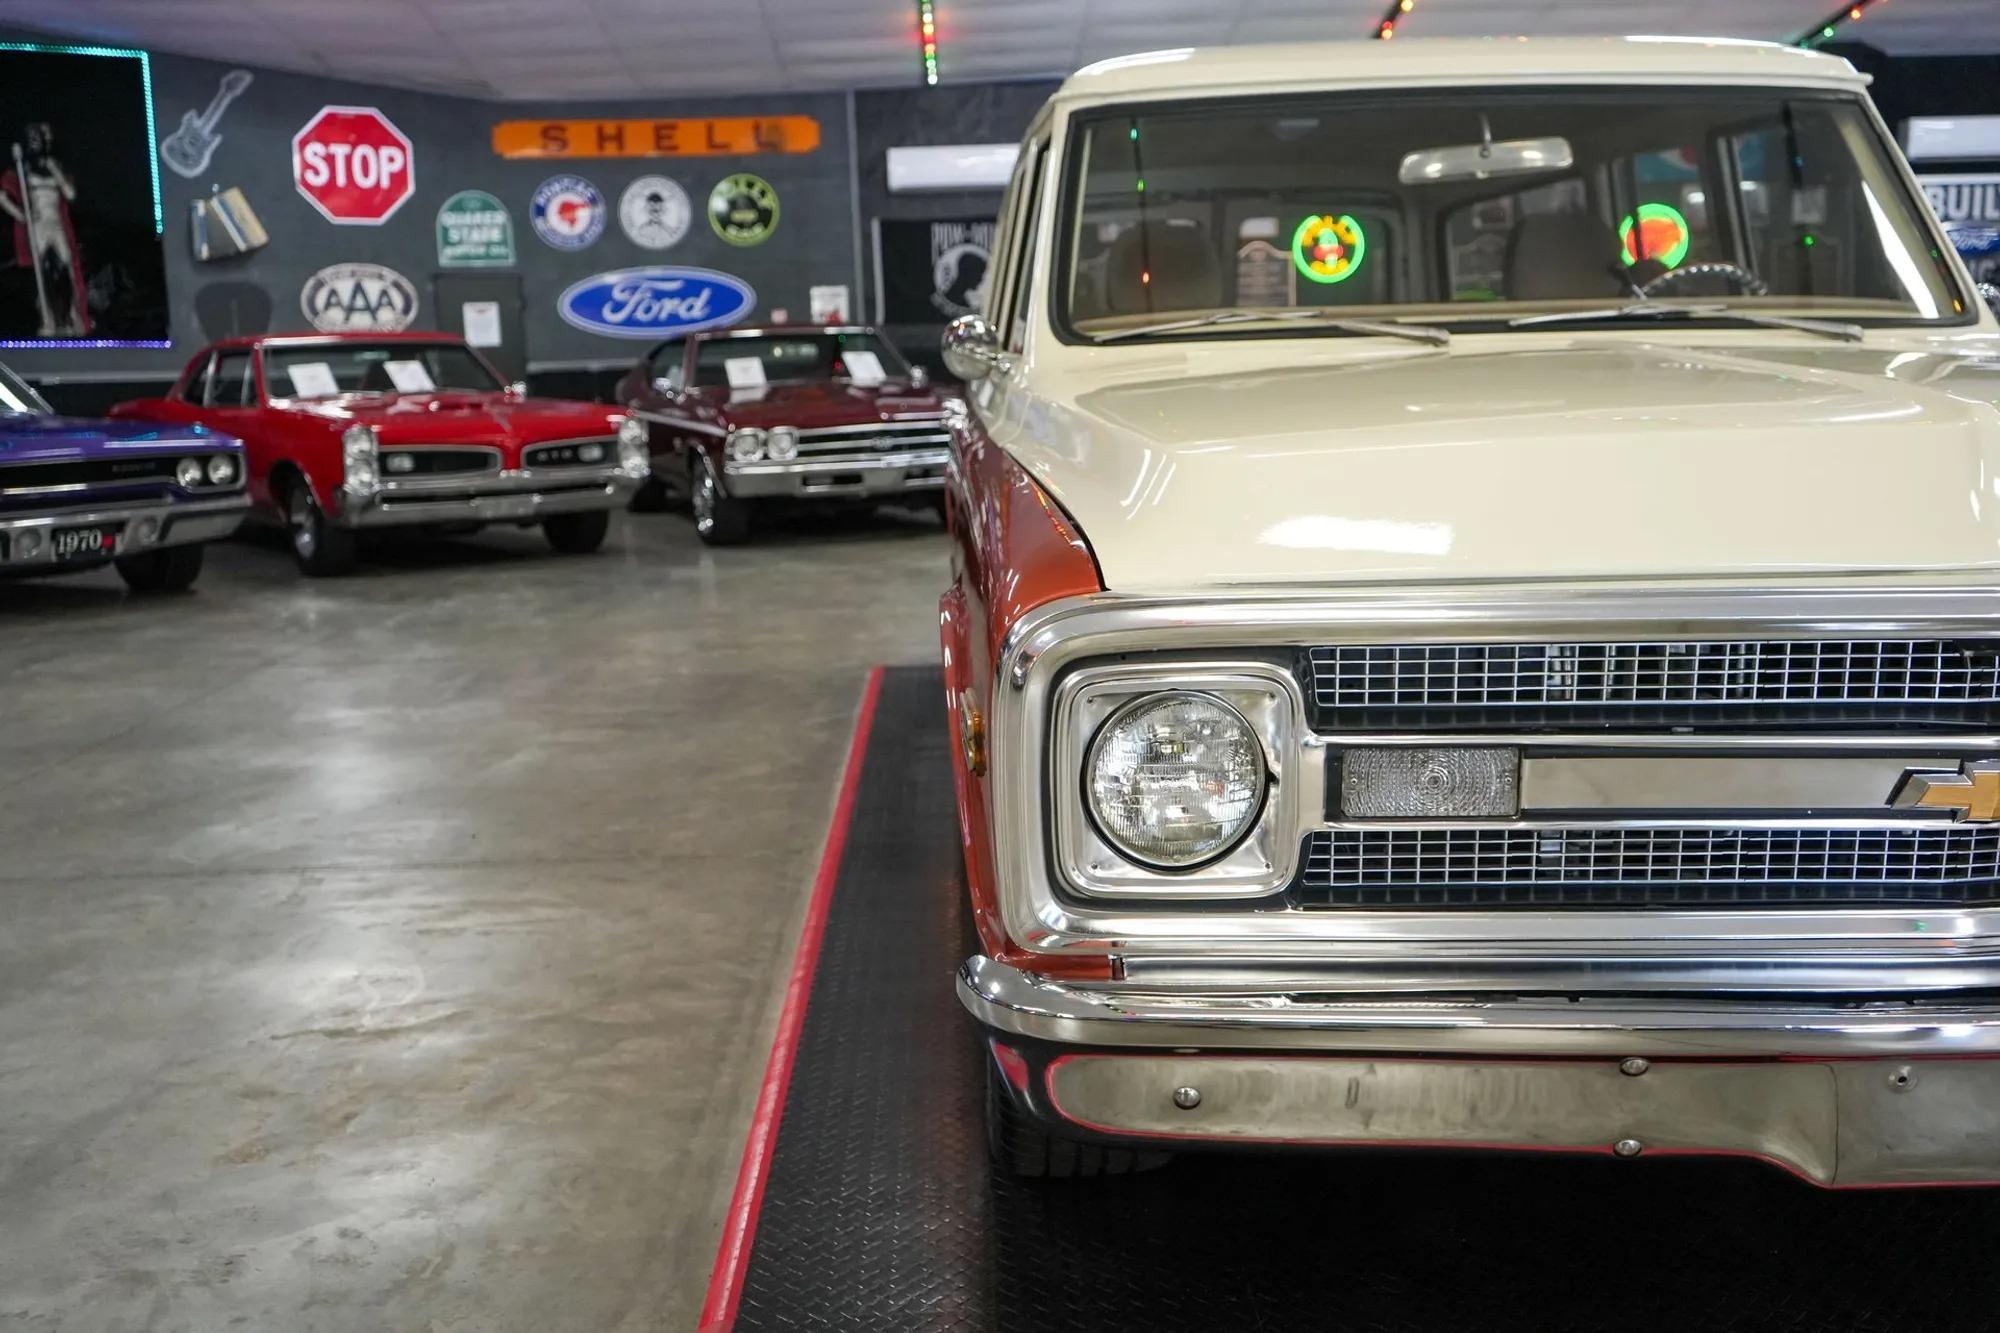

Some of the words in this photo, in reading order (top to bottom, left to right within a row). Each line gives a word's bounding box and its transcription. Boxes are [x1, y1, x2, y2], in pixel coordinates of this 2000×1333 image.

[540, 118, 783, 152] SHELL
[303, 141, 405, 190] STOP
[1924, 185, 2000, 221] BUIL
[447, 226, 501, 243] STATE
[324, 281, 396, 323] AAA
[602, 278, 713, 323] Ford
[57, 529, 103, 560] 1970
